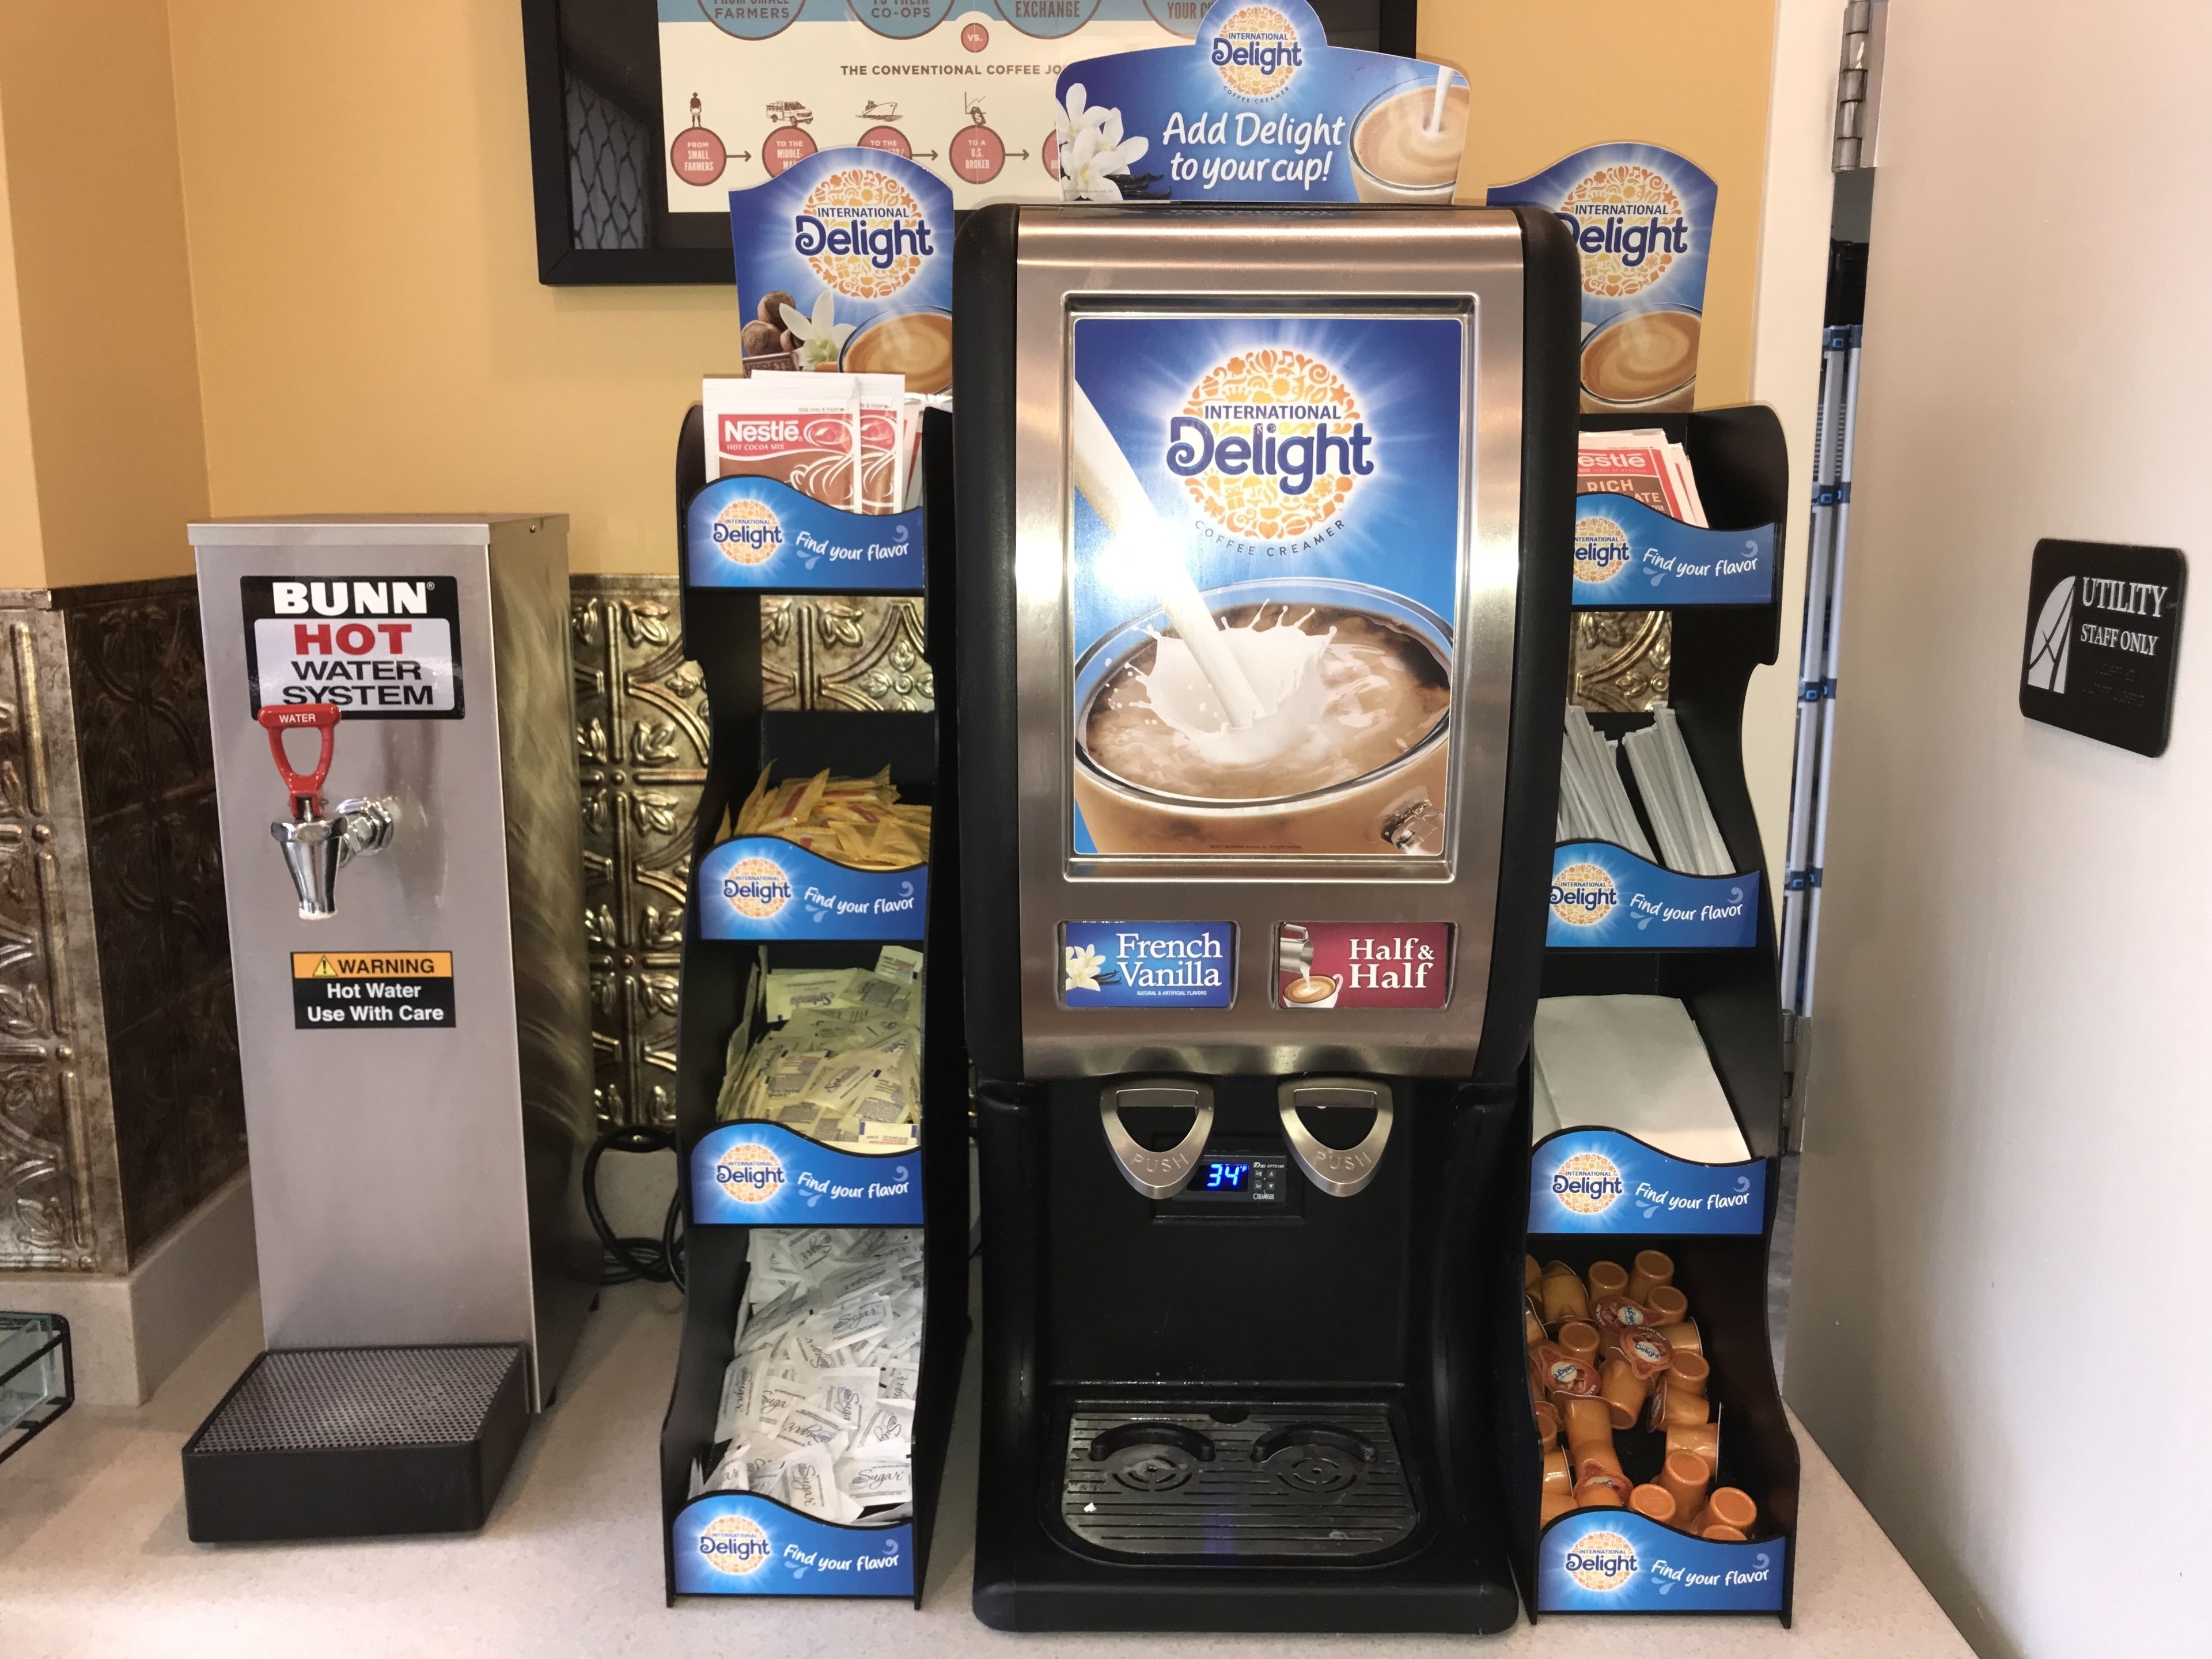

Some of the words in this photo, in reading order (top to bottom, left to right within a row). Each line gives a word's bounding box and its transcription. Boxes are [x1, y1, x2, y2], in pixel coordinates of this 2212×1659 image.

[715, 7, 789, 18] FARMERS
[871, 7, 931, 18] CO-OPS
[1016, 1, 1080, 18] EXCHANGE
[1167, 2, 1196, 19] YOUR
[1228, 32, 1288, 41] INTERNATIONAL
[1211, 37, 1302, 75] Delight
[841, 66, 868, 75] THE
[872, 65, 982, 75] CONVENTIONAL
[986, 65, 1040, 75] COFFEE
[1223, 86, 1250, 103] COFFEE
[1255, 86, 1290, 104] CREAMER
[1163, 112, 1226, 146] Add
[1236, 113, 1346, 154] Delight
[688, 150, 709, 160] SMALL
[965, 160, 990, 169] BROKER
[971, 148, 984, 157] U.S.
[684, 161, 714, 171] FARMERS
[1171, 152, 1198, 181] to
[1202, 157, 1271, 190] your
[1272, 151, 1333, 190] cup!
[817, 207, 909, 218] INTERNATIONAL
[1575, 204, 1669, 215] INTERNATIONAL
[795, 215, 934, 269] Delight
[1205, 405, 1342, 420] INTERNATIONAL
[1166, 416, 1374, 495] Delight
[1578, 452, 1646, 468] estlé
[1586, 479, 1634, 493] RICH
[713, 523, 783, 550] Delight
[796, 531, 829, 555] Find
[830, 546, 863, 561] your
[868, 543, 908, 560] flavor
[1195, 520, 1255, 555] COFFEE
[1266, 519, 1346, 557] CREAMER
[1575, 543, 1630, 567] elight
[1643, 548, 1676, 571] Find
[1676, 563, 1710, 577] your
[1715, 558, 1758, 576] flavor
[2082, 577, 2168, 618] UTILITY
[294, 623, 412, 656] HOT
[2081, 623, 2119, 648] STAFF
[2120, 631, 2159, 656] ONLY
[291, 661, 422, 680] WATER
[283, 685, 434, 706] SYSTEM
[279, 713, 316, 724] WATER
[724, 880, 791, 904] Delight
[804, 887, 836, 909] Find
[837, 900, 869, 914] your
[874, 897, 914, 914] flavor
[1550, 885, 1618, 911] Delight
[1630, 892, 1664, 916] Find
[1662, 907, 1696, 922] your
[1700, 903, 1743, 922] flavor
[1116, 933, 1224, 959] French
[338, 959, 434, 974] WARNING
[1116, 961, 1222, 988] Vanilla
[1349, 962, 1434, 989] Half
[327, 983, 361, 999] Hot
[366, 983, 422, 998] Water
[308, 1006, 345, 1022] Use
[350, 1006, 393, 1021] With
[399, 1005, 444, 1021] Care
[1130, 1153, 1189, 1172] PUSH
[1314, 1151, 1372, 1170] PUSH
[716, 1165, 785, 1189] Delight
[797, 1172, 830, 1194] Find
[831, 1185, 865, 1199] your
[868, 1182, 909, 1199] flavor
[1552, 1175, 1623, 1200] Delight
[1635, 1182, 1670, 1205] Find
[1668, 1196, 1703, 1210] your
[1707, 1192, 1750, 1210] flavor
[1634, 1343, 1660, 1359] Delight
[834, 1392, 859, 1421] Suga
[857, 1468, 903, 1490] Sugar
[700, 1536, 770, 1560] Delight
[783, 1543, 817, 1566] Find
[818, 1557, 852, 1571] your
[857, 1554, 899, 1571] flavor
[1565, 1553, 1638, 1577] Delight
[1651, 1559, 1685, 1580] Find
[1685, 1572, 1721, 1586] your
[1725, 1569, 1770, 1585] flavor
